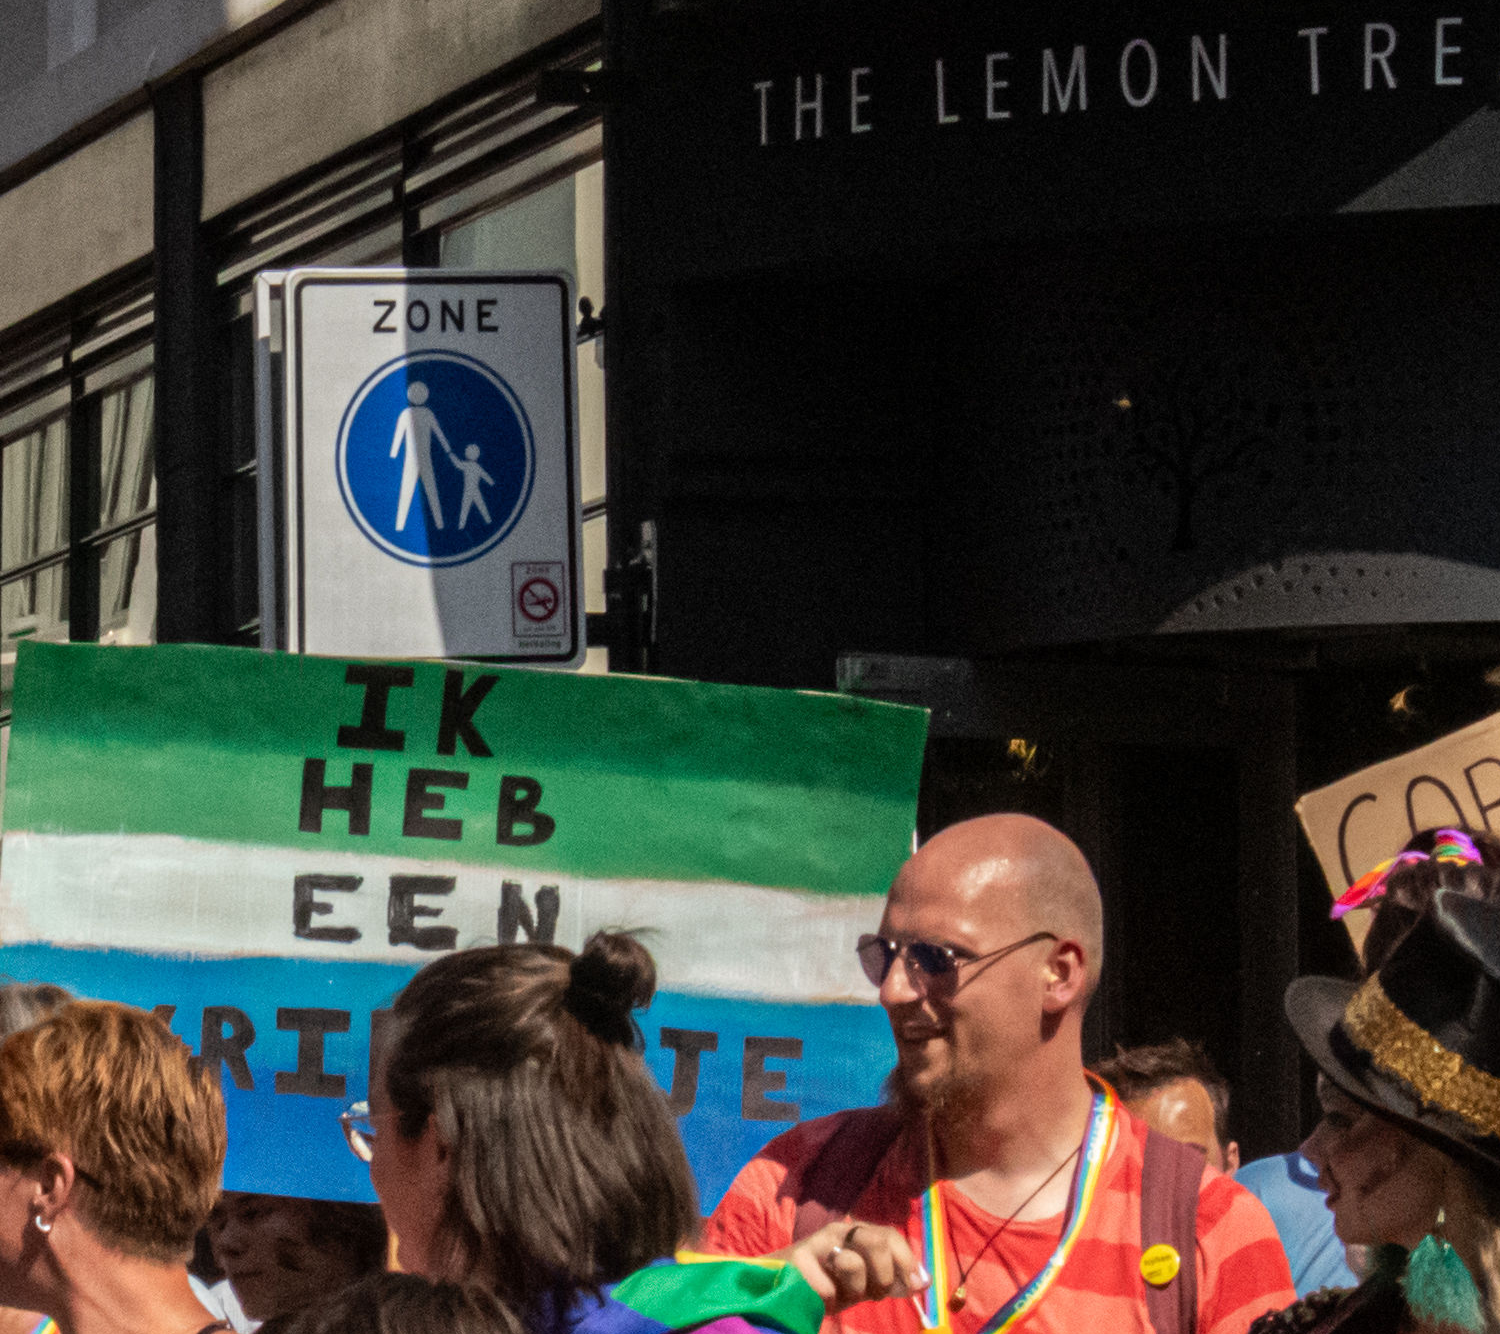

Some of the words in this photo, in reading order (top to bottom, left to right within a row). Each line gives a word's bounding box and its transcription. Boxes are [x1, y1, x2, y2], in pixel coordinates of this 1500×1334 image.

[753, 67, 872, 147] THE
[935, 33, 1228, 124] LEMON
[372, 298, 500, 334] ZONE
[336, 663, 501, 758] IK
[298, 757, 557, 847] HEB
[292, 873, 561, 951] EEN
